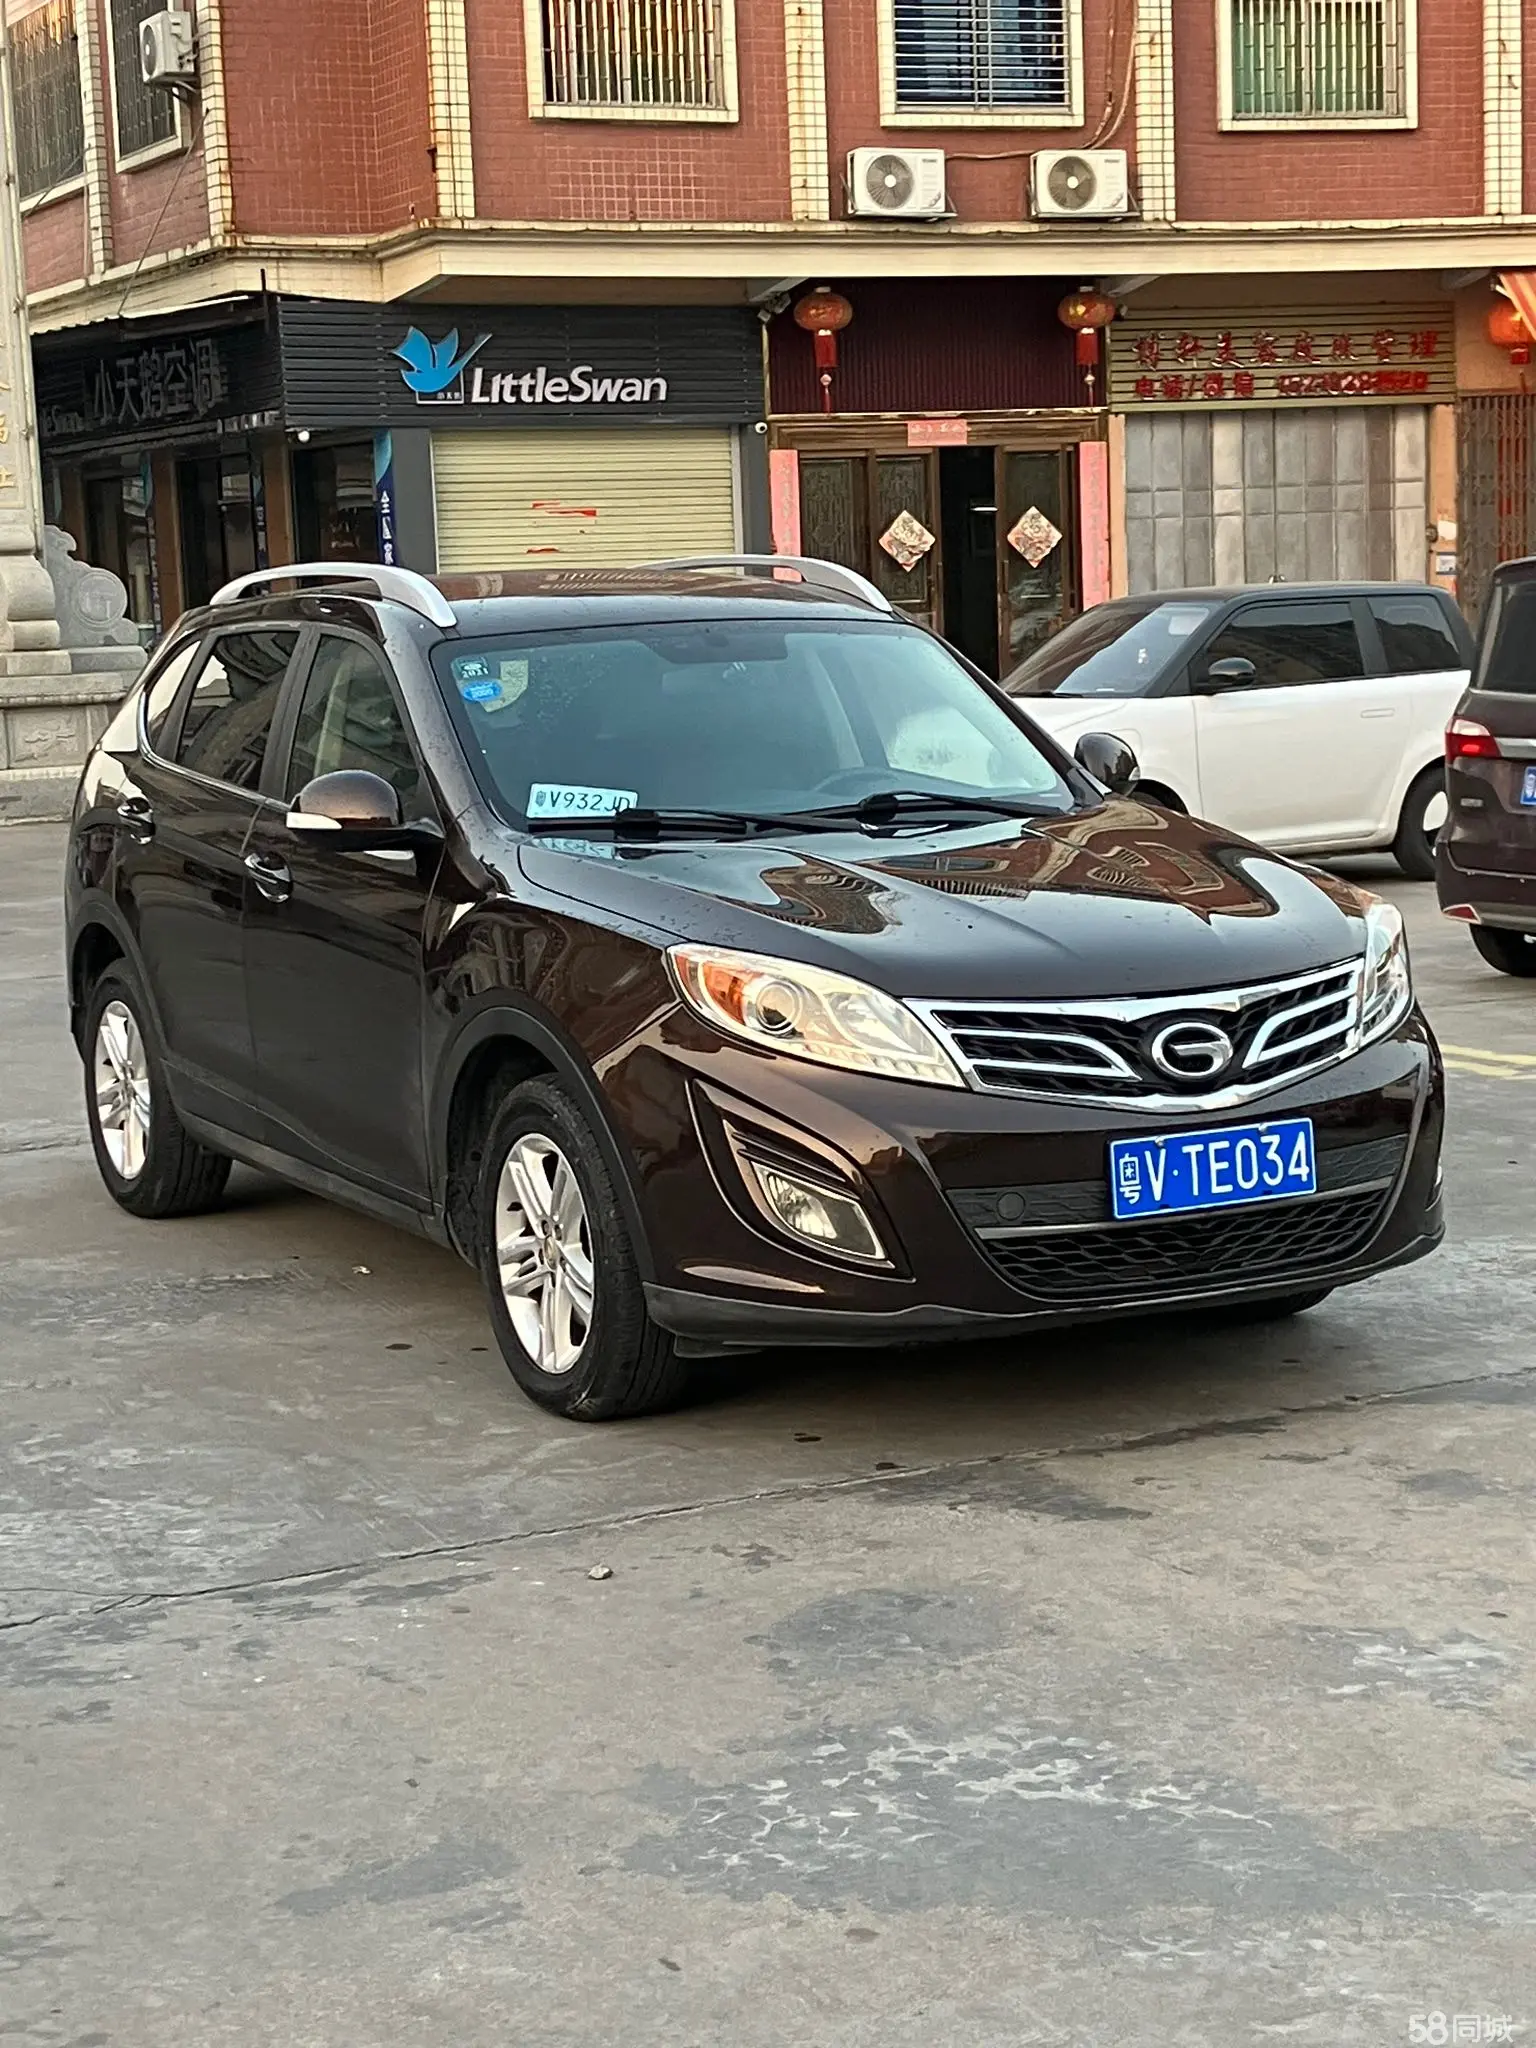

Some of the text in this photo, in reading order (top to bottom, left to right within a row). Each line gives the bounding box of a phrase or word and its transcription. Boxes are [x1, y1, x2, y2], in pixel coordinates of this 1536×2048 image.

[93, 337, 222, 424] 小天鹅空调
[471, 365, 667, 404] LittleSwan
[1119, 1131, 1310, 1205] 粤V·TE034
